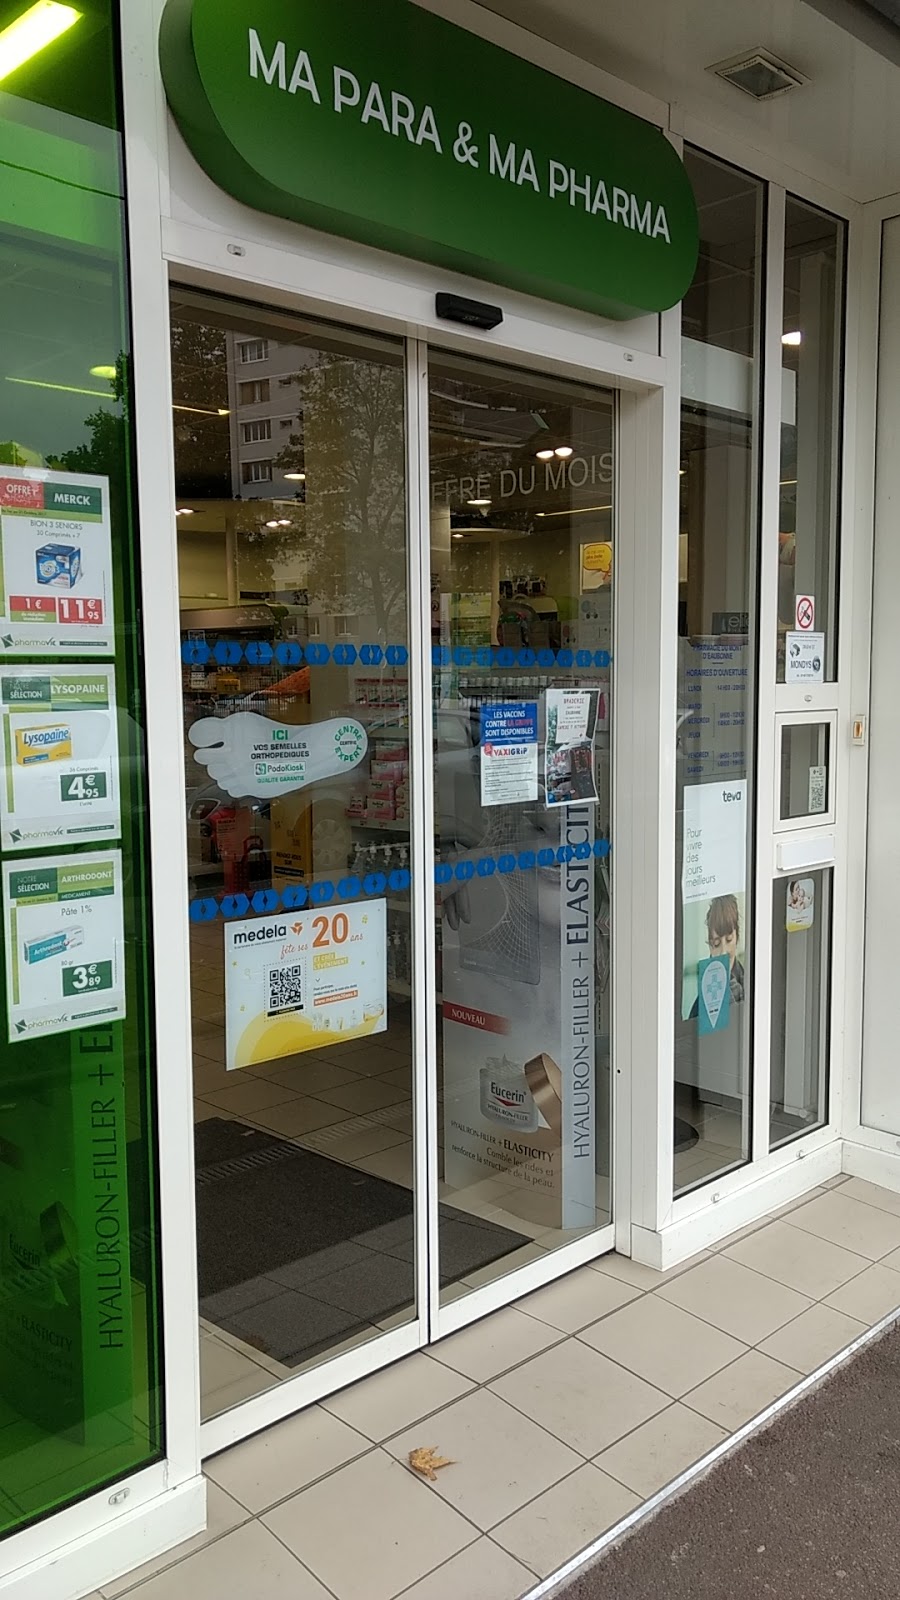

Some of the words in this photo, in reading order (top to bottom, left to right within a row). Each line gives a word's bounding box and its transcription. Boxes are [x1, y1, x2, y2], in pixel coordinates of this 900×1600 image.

[248, 28, 320, 104] MA
[333, 65, 443, 154] PARA
[453, 121, 479, 168] &
[489, 134, 540, 192] MA
[549, 160, 671, 244] PHARMA
[431, 473, 491, 506] FFRE
[500, 465, 536, 498] DU
[545, 453, 612, 491] MOIS
[6, 484, 31, 496] OFFRE
[54, 493, 91, 506] MERCK
[30, 520, 48, 528] BION
[55, 522, 83, 531] SENIORS
[686, 669, 713, 677] HORAIRES
[51, 684, 105, 694] LYSOPAINE
[503, 710, 525, 718] VACCINS
[485, 720, 507, 728] CONTRE
[24, 728, 69, 747] Lysopaïne
[272, 730, 288, 740] ICI
[335, 725, 362, 741] CENTRE
[485, 729, 500, 737] SONT
[500, 727, 534, 736] DISPONIBLES
[270, 742, 307, 750] SEMELLES
[251, 750, 310, 760] ORTHOPEDIQUES
[335, 744, 362, 762] EXPERT
[267, 763, 304, 773] PodoKiosk
[722, 790, 742, 803] teva
[686, 827, 702, 839] Pour
[686, 853, 699, 863] des
[61, 871, 112, 883] ARTHRODONT
[566, 805, 589, 945] ELASTCIT
[685, 865, 703, 879] jours
[18, 882, 50, 893] SÉLECTION
[686, 875, 716, 888] meilleurs
[61, 907, 78, 917] Pâte
[81, 904, 92, 914] 1%
[234, 924, 287, 944] medela
[312, 912, 349, 948] 20
[280, 944, 295, 959] fête
[298, 944, 308, 952] ses
[452, 1008, 486, 1026] NOUVEAU
[572, 976, 590, 1159] HYALURON-FILLER
[491, 1082, 524, 1103] Eucerin
[451, 1120, 496, 1145] HYALURON-FILLER
[504, 1139, 554, 1162] ELASTICITY
[486, 1147, 512, 1163] Comble
[513, 1157, 524, 1166] les
[451, 1145, 476, 1160] renforce
[476, 1153, 482, 1163] la
[483, 1158, 512, 1175] structure
[513, 1169, 522, 1178] de
[524, 1173, 531, 1182] la
[91, 1097, 124, 1349] HYALURON-FILLER
